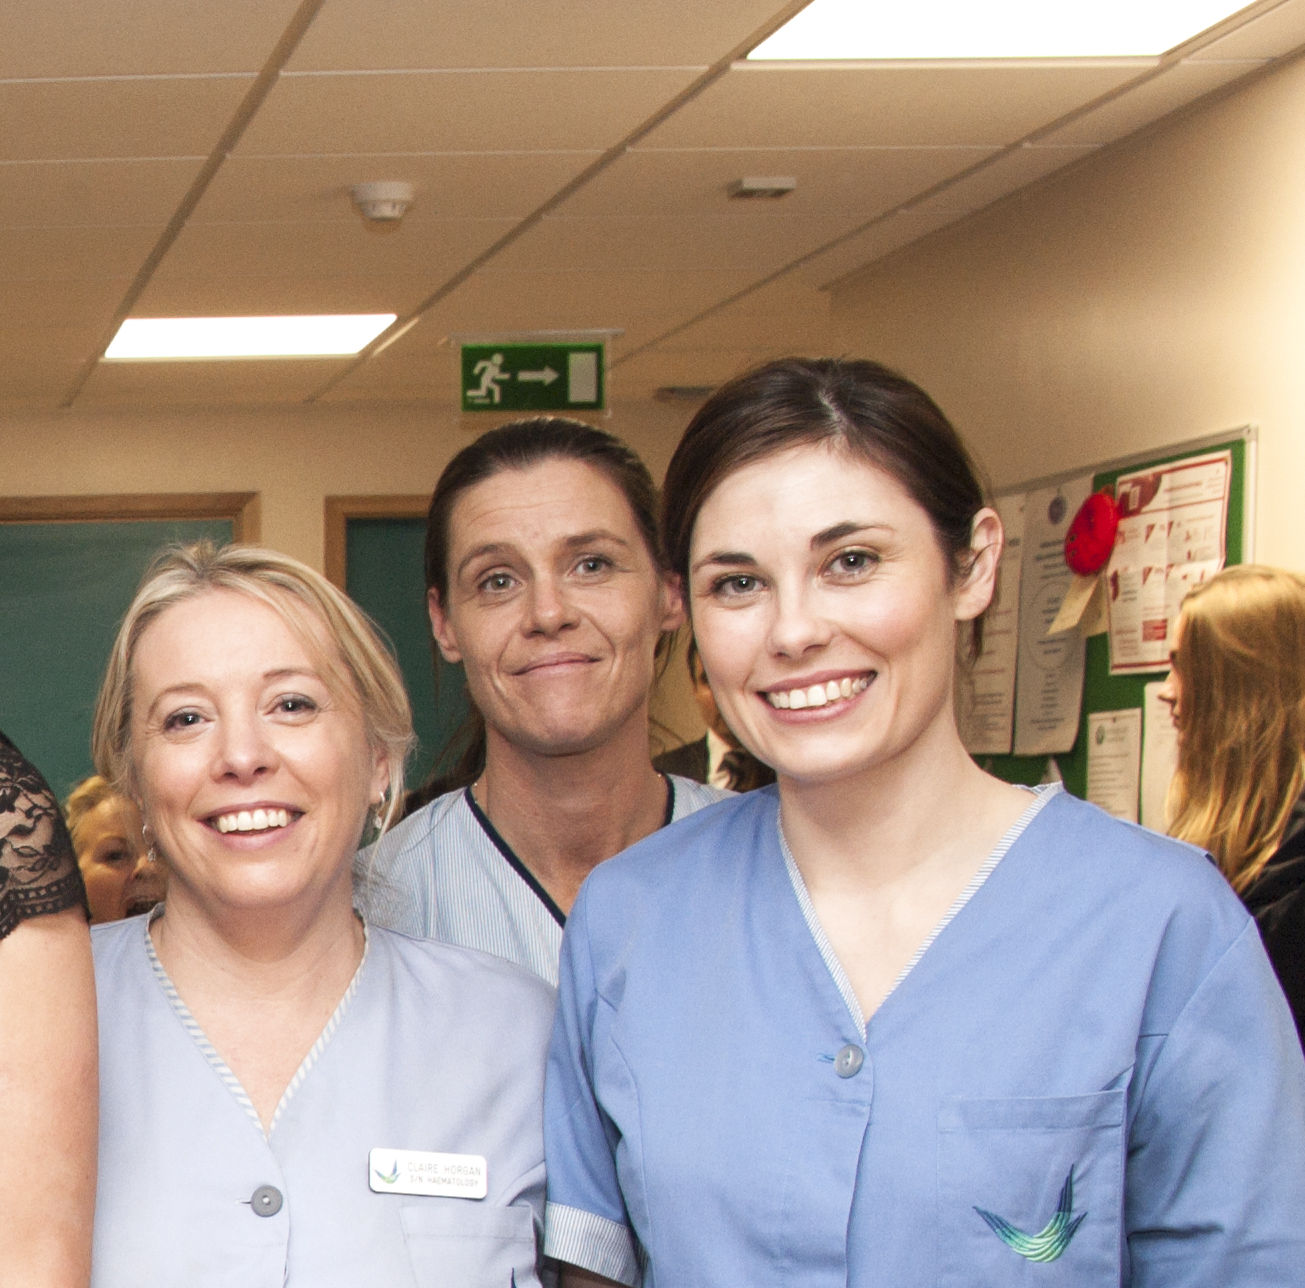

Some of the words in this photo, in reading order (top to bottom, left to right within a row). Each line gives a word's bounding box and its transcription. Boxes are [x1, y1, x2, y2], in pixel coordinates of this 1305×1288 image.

[407, 1162, 438, 1174] CLAIRE
[444, 1165, 481, 1176] HORGAN
[428, 1177, 479, 1187] HAEMATOLOGY
